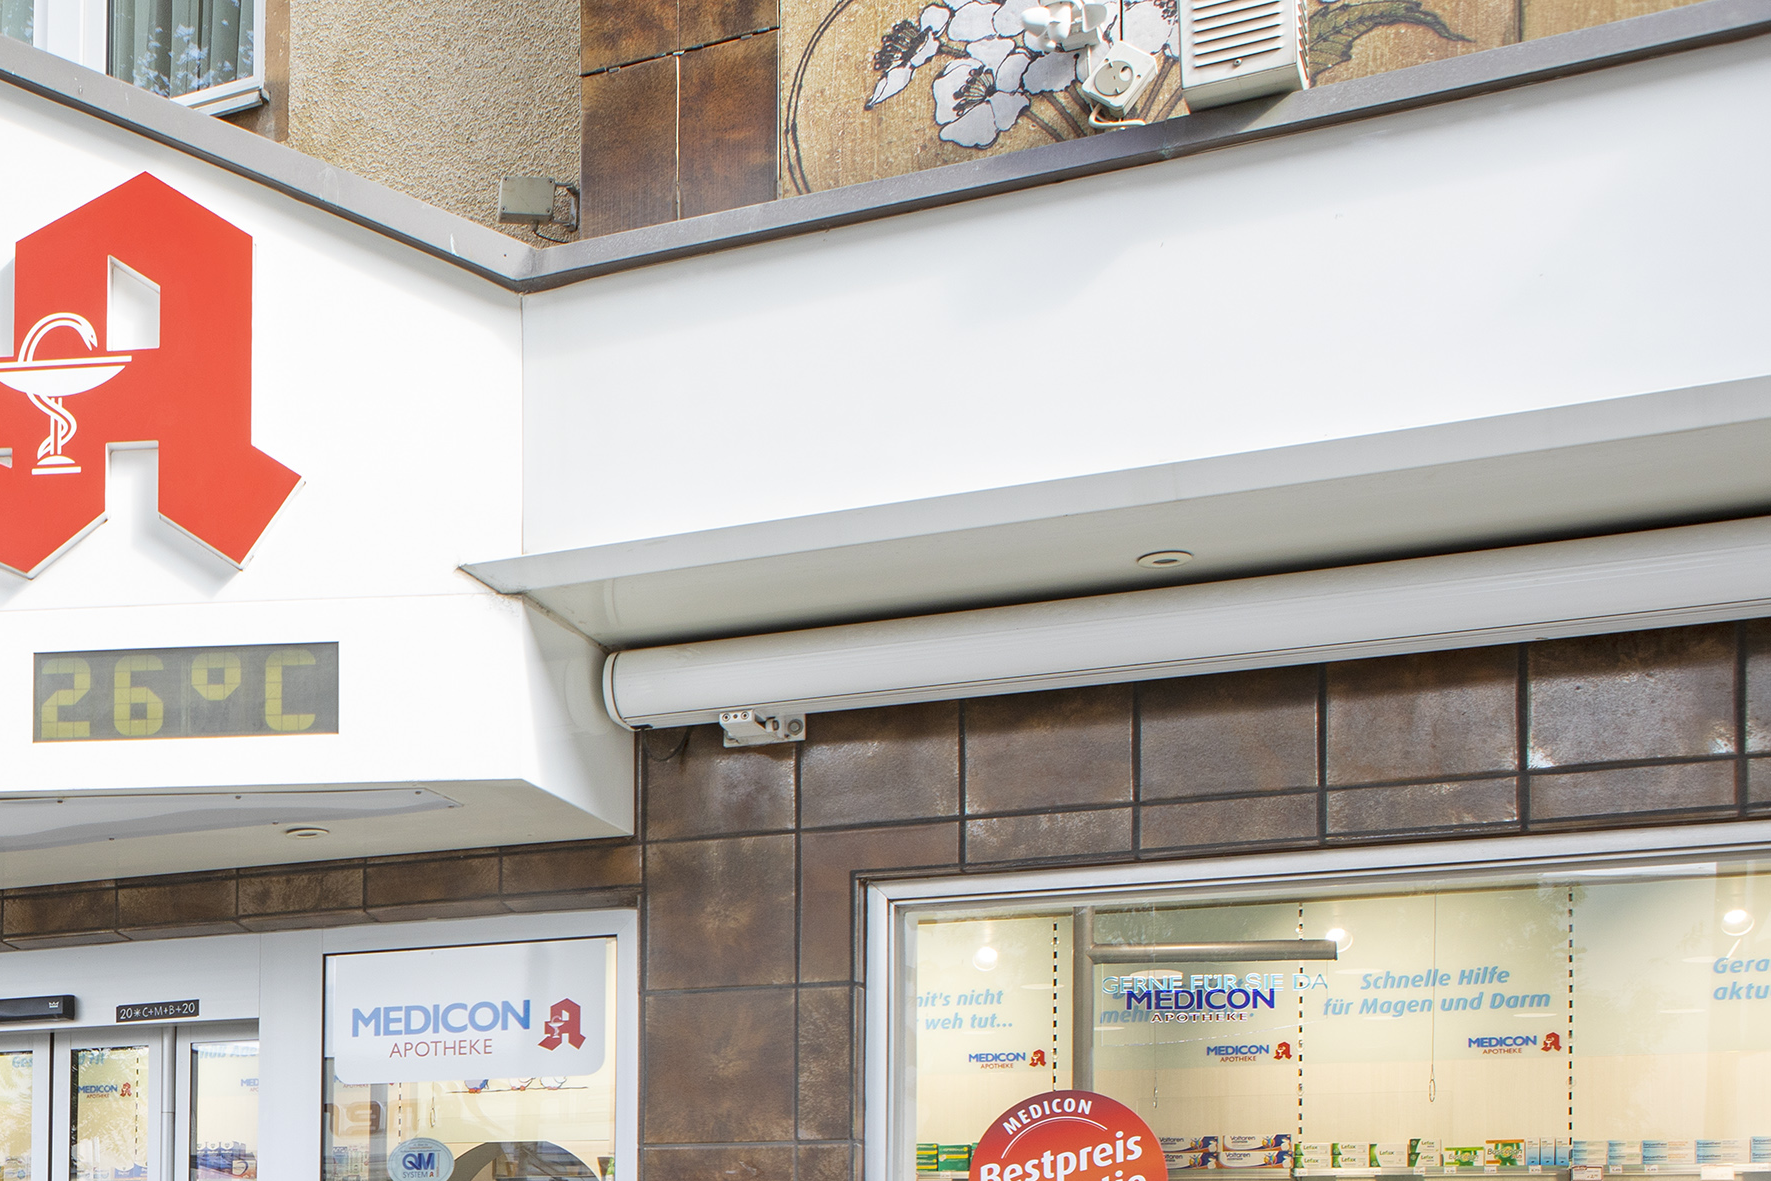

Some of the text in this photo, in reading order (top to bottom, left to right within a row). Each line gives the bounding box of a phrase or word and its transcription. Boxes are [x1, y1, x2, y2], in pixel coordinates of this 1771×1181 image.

[1102, 973, 1328, 994] GERNE FÜR SIE DA
[1360, 966, 1510, 991] Schnelle Hilfe
[956, 989, 1003, 1006] nicht
[1126, 988, 1276, 1011] MEDICON
[1323, 991, 1550, 1018] für Magen und Darm
[352, 1000, 531, 1037] MEDICON
[925, 1013, 1013, 1030] weh tut...
[1150, 1012, 1248, 1023] APOTHEKE
[389, 1038, 493, 1058] APOTHEKE
[1206, 1044, 1270, 1056] MEDICON
[1468, 1035, 1537, 1049] MEDICON
[1482, 1047, 1523, 1055] APOTHEKE
[968, 1052, 1026, 1063] MEDICON
[78, 1084, 118, 1094] MEDICON
[1002, 1098, 1092, 1135] MEDICON
[402, 1152, 435, 1171] QM
